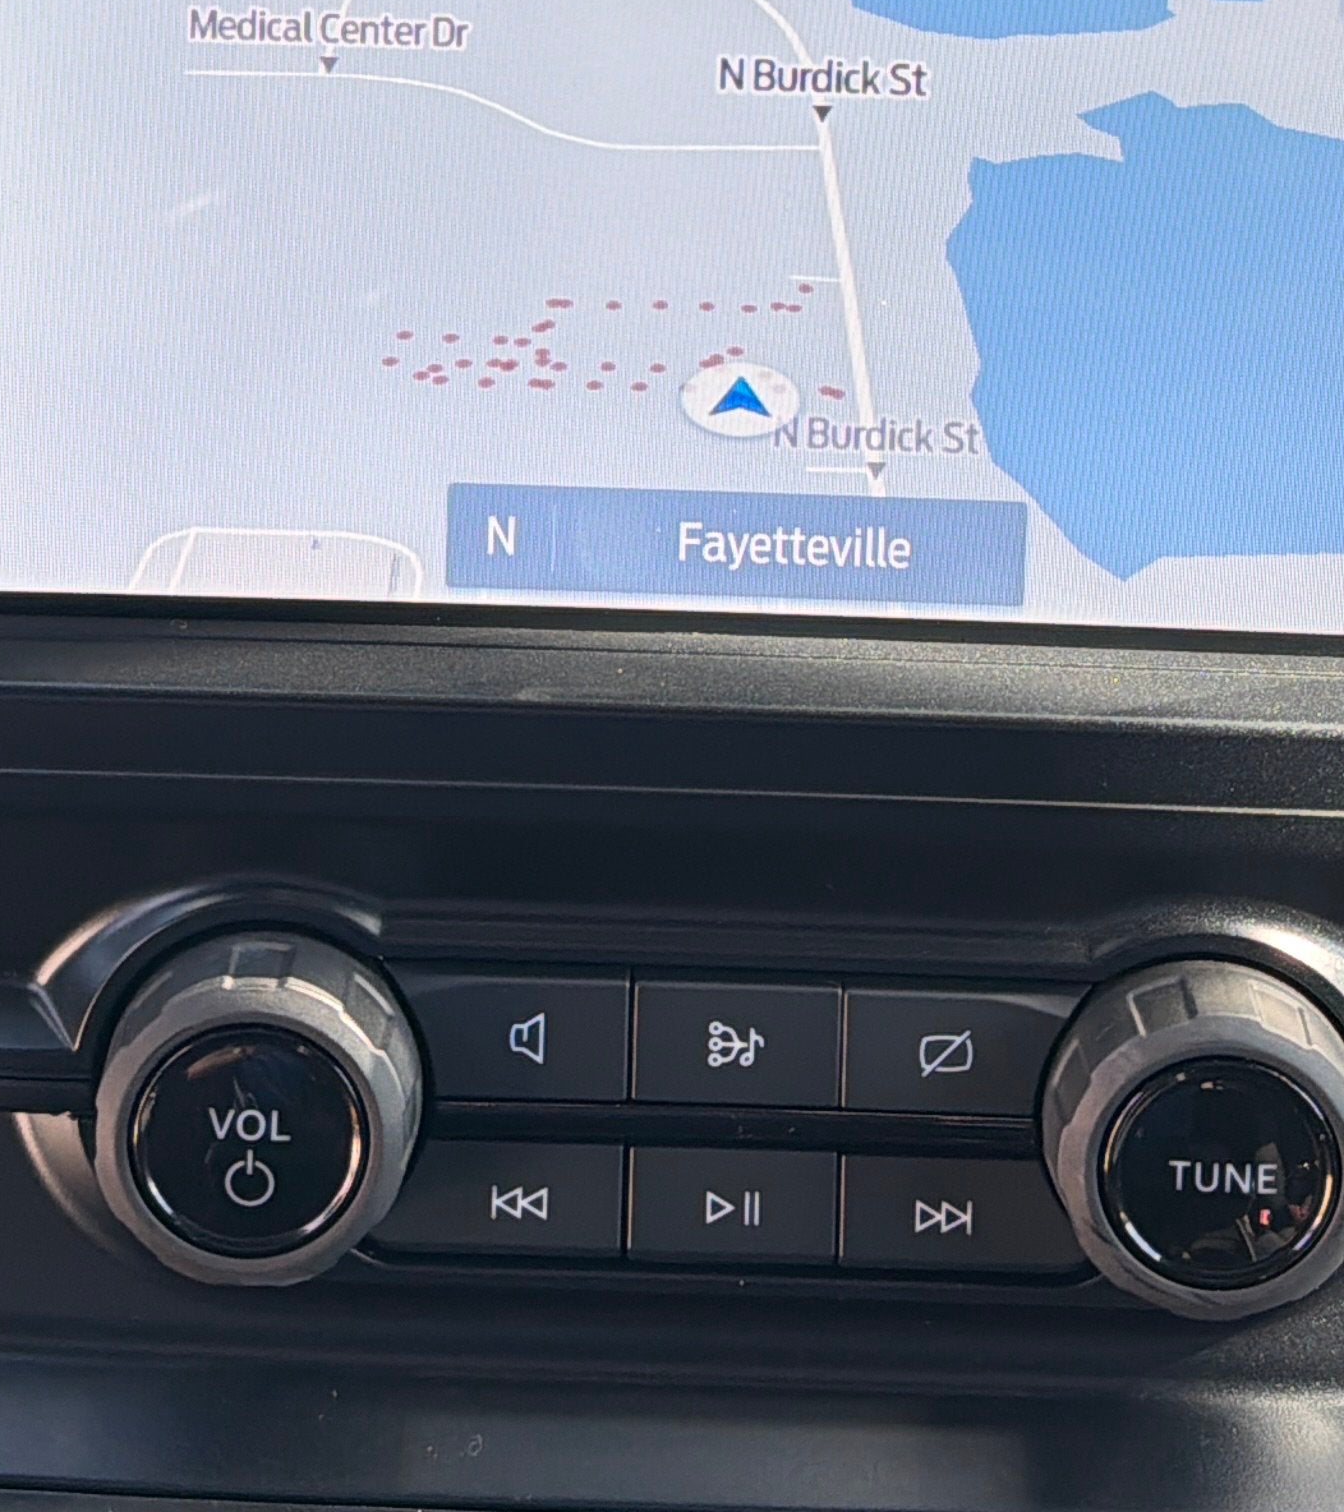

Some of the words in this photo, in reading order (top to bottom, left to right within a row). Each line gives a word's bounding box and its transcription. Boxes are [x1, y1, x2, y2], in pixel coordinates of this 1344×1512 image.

[189, 8, 312, 43] Medical
[320, 12, 429, 46] Center
[432, 16, 469, 48] Dr
[720, 57, 744, 90] N
[754, 58, 880, 94] Burdick
[890, 63, 928, 96] St
[774, 416, 799, 448] N
[807, 416, 934, 454] Burdick
[943, 421, 980, 454] St
[486, 516, 516, 556] N
[677, 521, 911, 570] Fayetteville
[208, 1106, 291, 1142] VOL
[1169, 1159, 1278, 1195] TUNE
